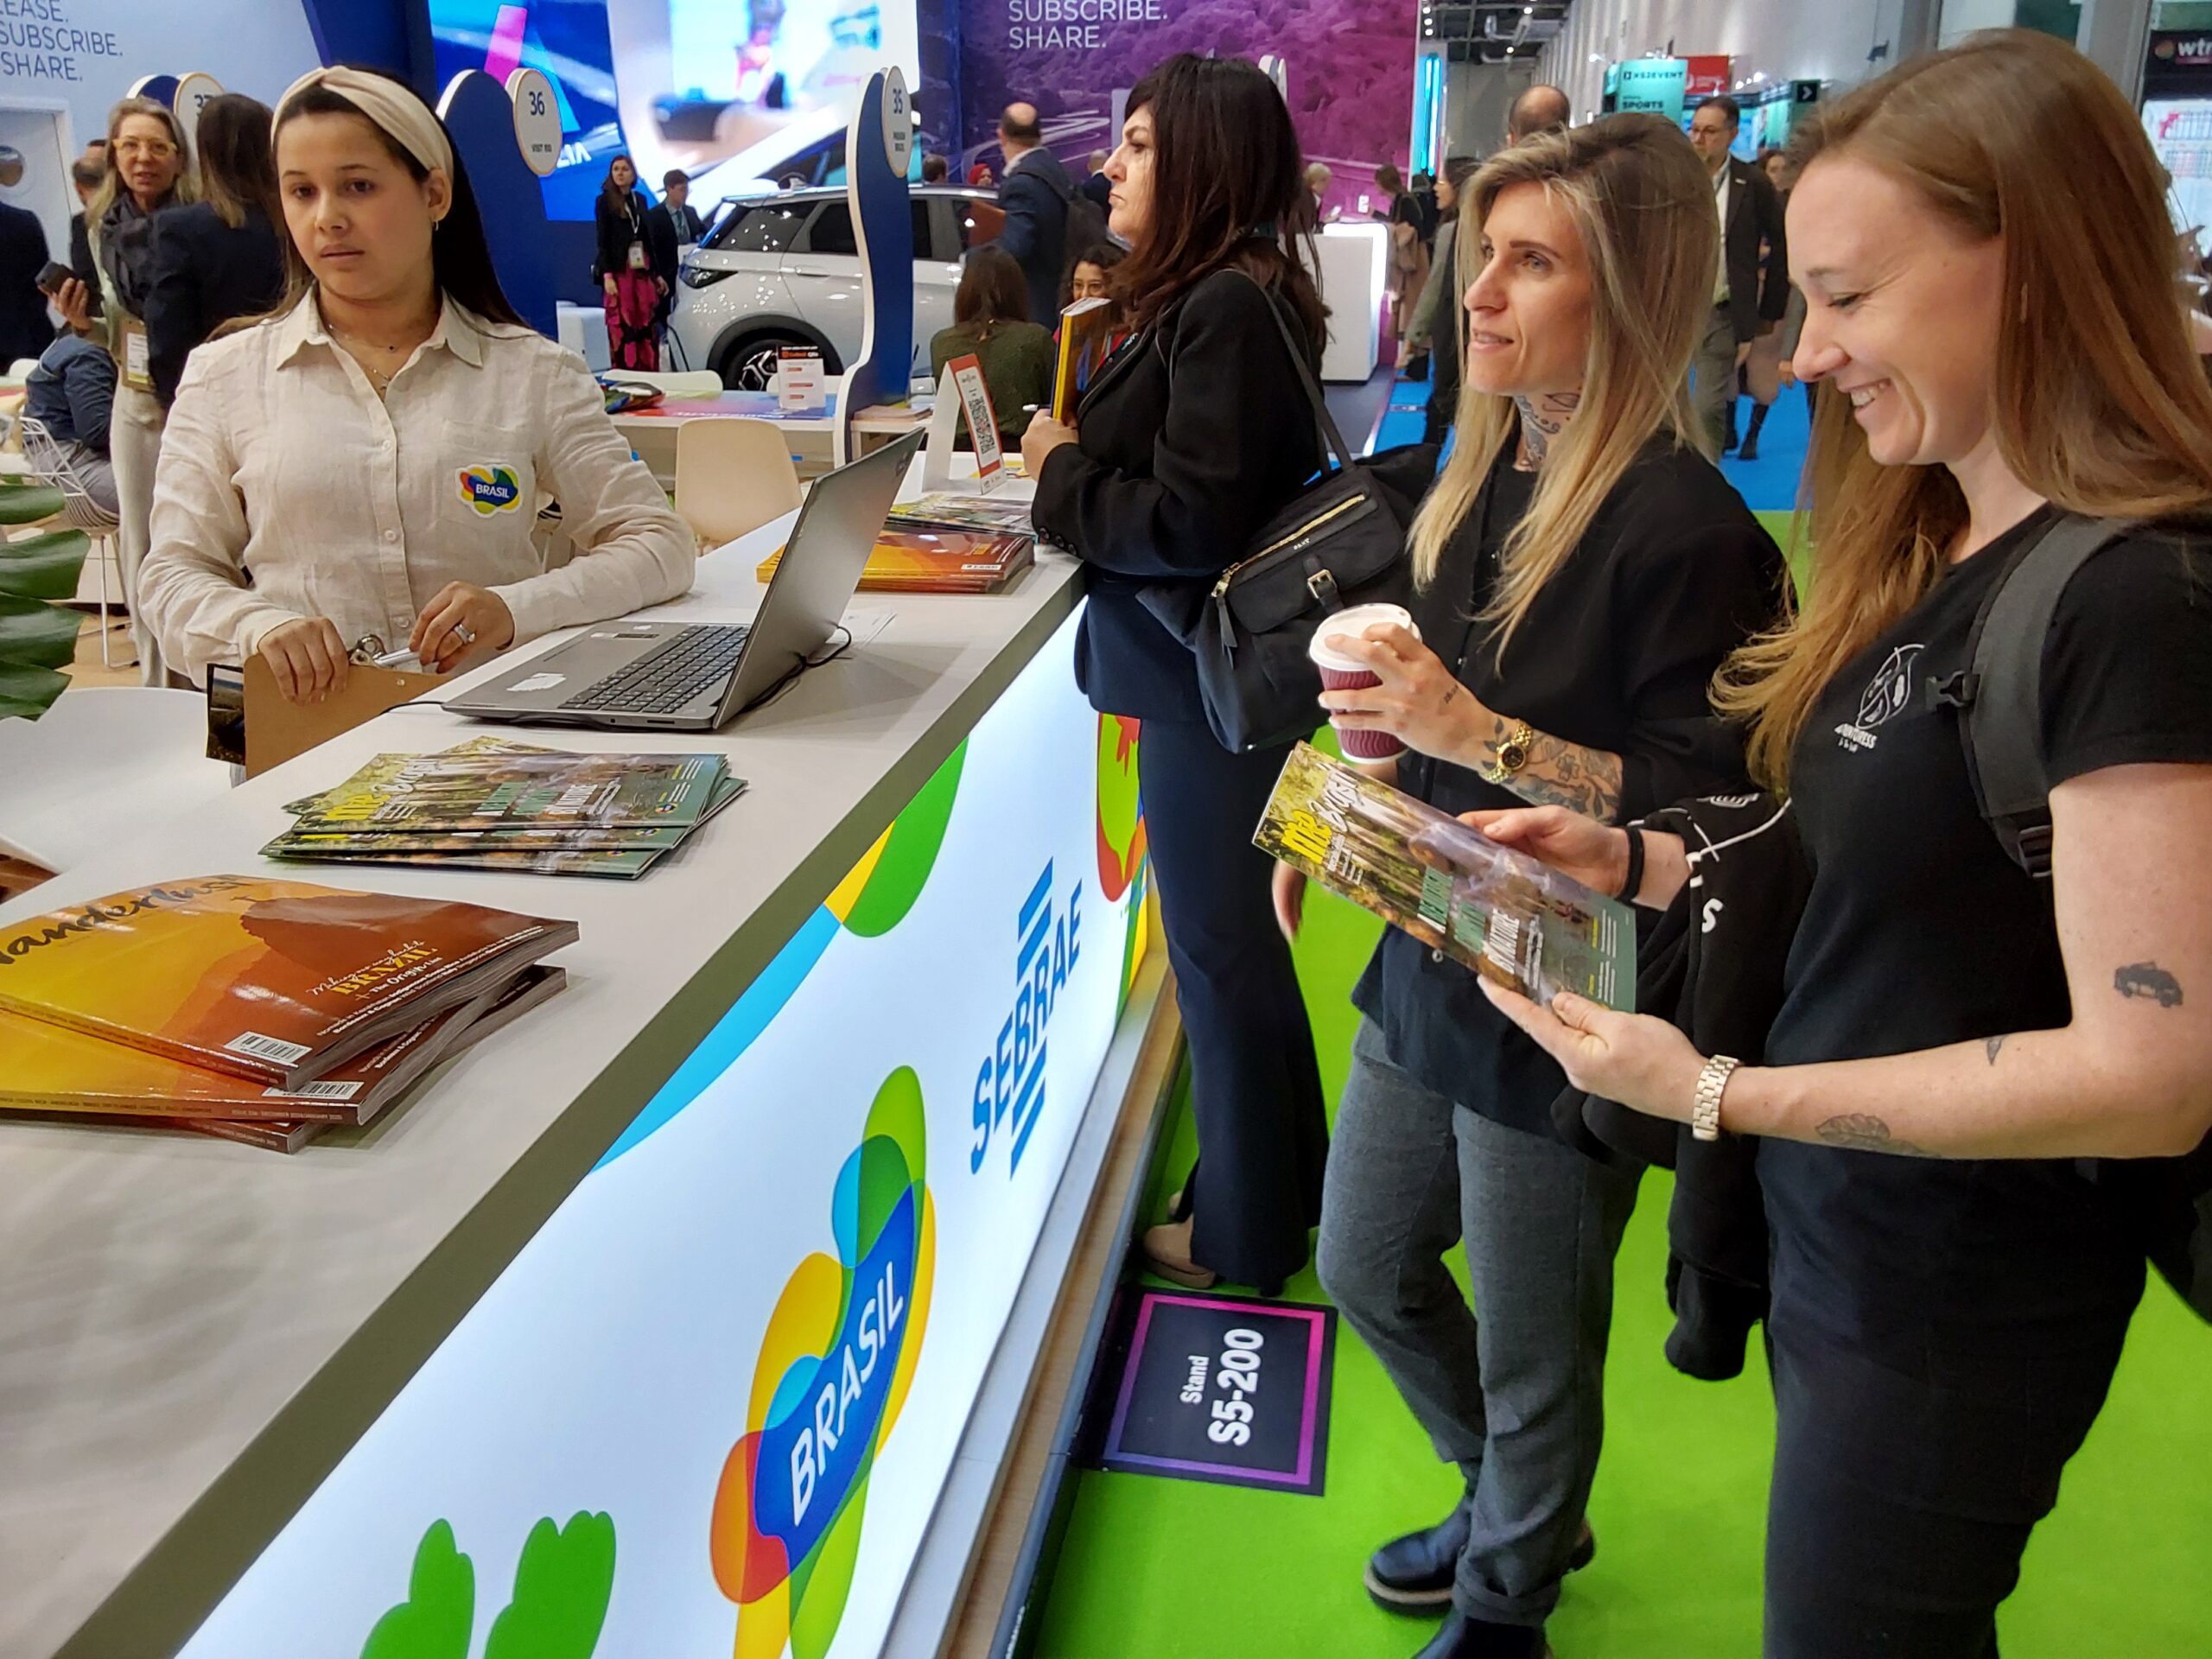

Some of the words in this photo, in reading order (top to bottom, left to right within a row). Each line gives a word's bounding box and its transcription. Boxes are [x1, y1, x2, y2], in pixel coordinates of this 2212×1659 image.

[0, 0, 68, 22] EASE.
[1009, 0, 1168, 22] SUBSCRIBE.
[0, 21, 123, 56] SUBSCRIBE.
[1009, 26, 1107, 49] SHARE.
[1, 51, 83, 81] SHARE.
[529, 91, 545, 116] 36
[893, 88, 903, 114] 35
[475, 483, 510, 499] BRASIL
[1489, 908, 1519, 956] NATURE
[330, 948, 438, 995] BRAZIL
[369, 983, 390, 993] The
[970, 877, 1082, 1175] SEBRAE
[791, 1261, 903, 1526] BRASIL
[1179, 1355, 1210, 1405] Stand
[1207, 1328, 1264, 1446] S5-200
